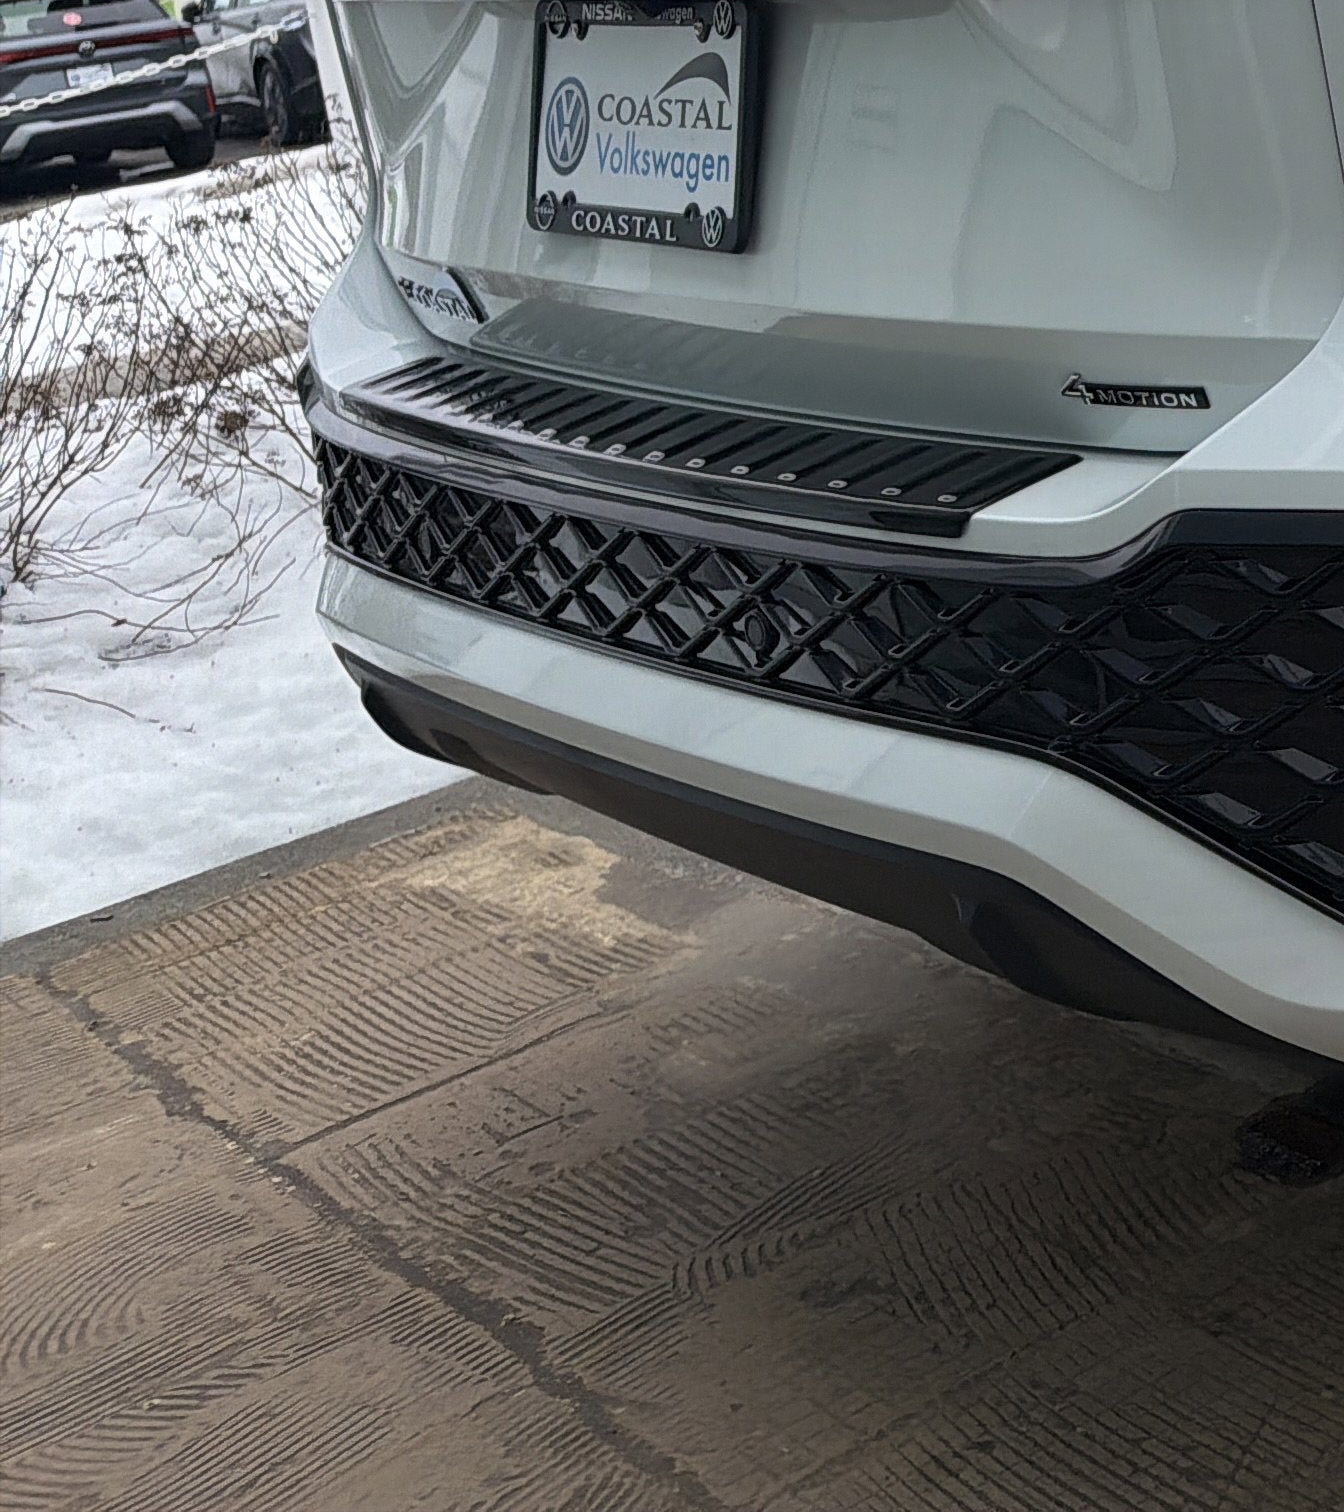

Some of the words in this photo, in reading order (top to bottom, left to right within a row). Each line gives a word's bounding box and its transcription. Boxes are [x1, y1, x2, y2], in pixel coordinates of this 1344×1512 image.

[597, 93, 733, 131] COASTAL
[596, 131, 730, 193] Volkswagen
[571, 210, 677, 242] COASTAL
[1061, 373, 1198, 406] 4MOTION
